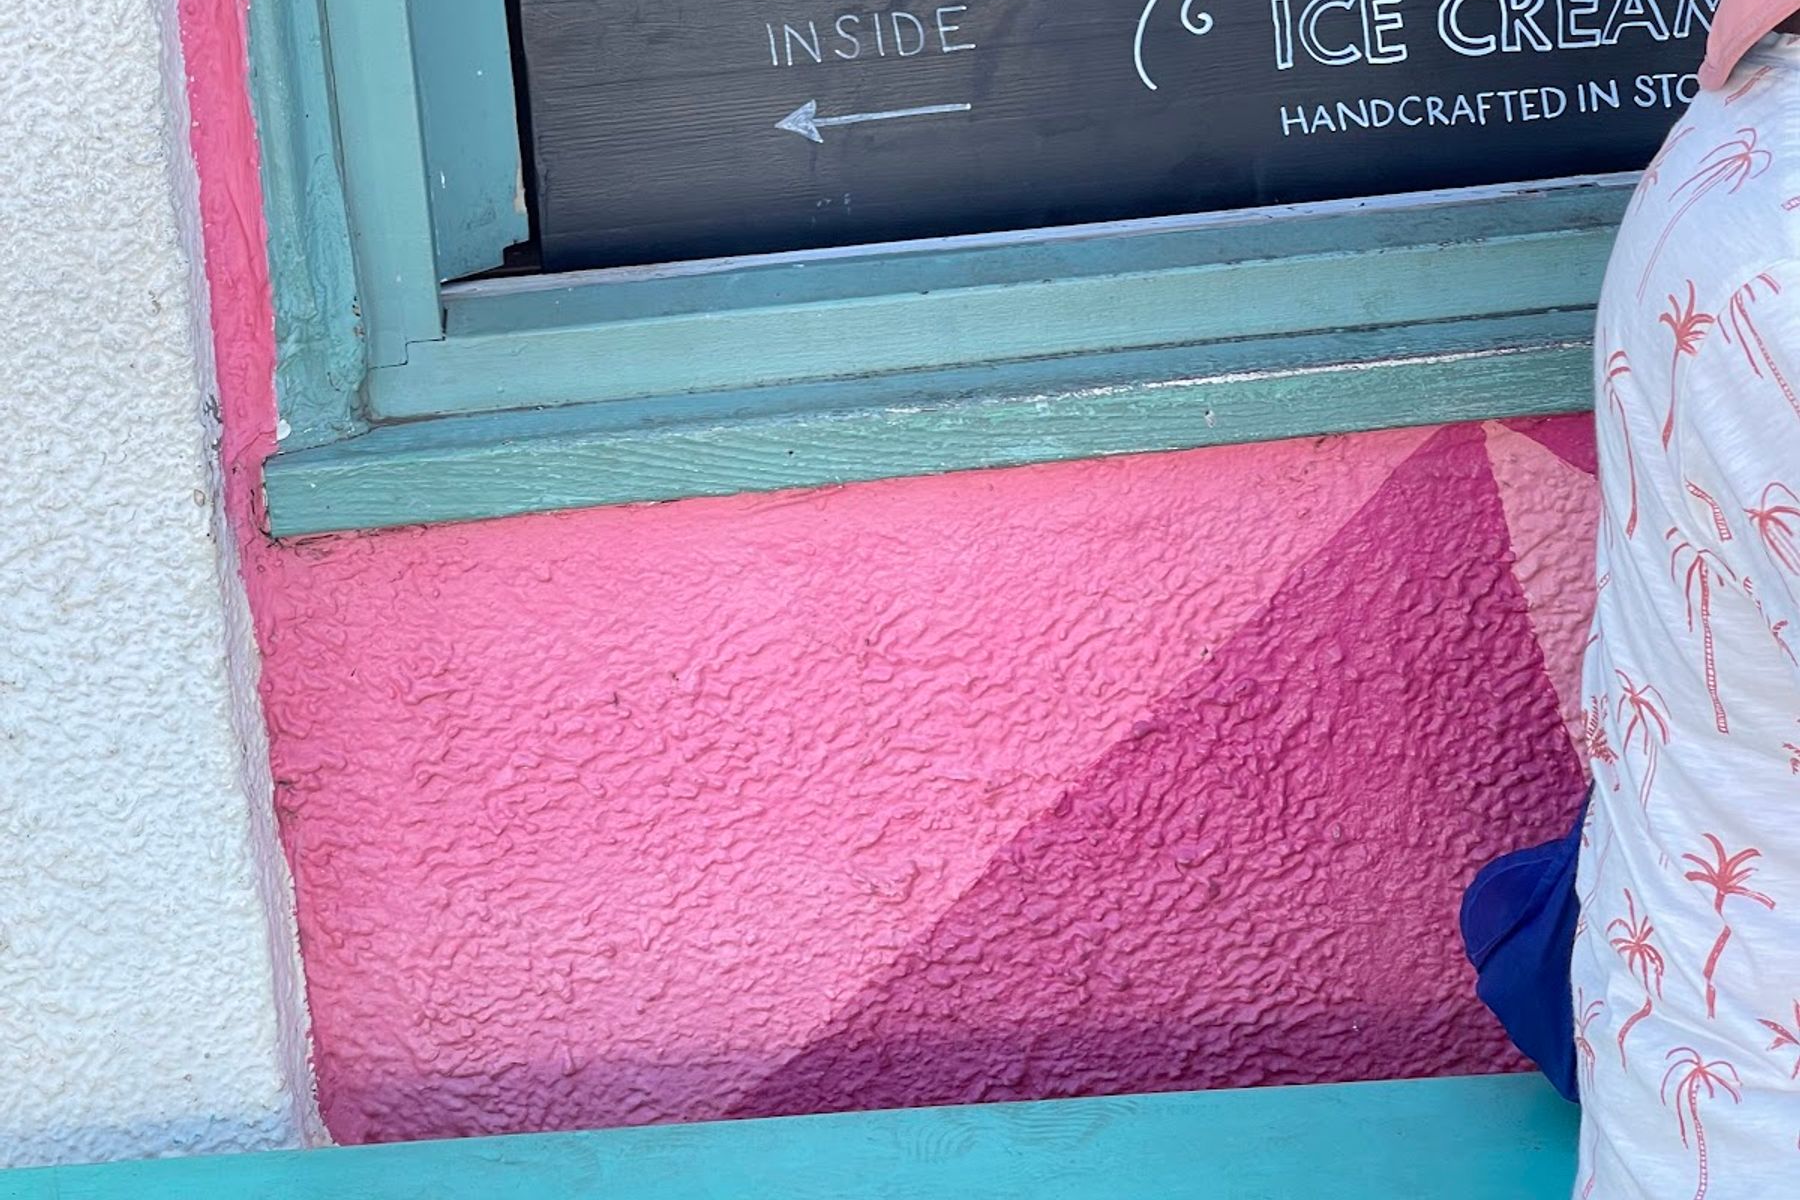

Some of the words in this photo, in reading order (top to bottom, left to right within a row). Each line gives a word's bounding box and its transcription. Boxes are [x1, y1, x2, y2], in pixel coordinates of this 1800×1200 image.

[766, 5, 977, 66] INSIDE
[1280, 87, 1568, 137] HANDCRAFTED
[1578, 79, 1620, 113] IN
